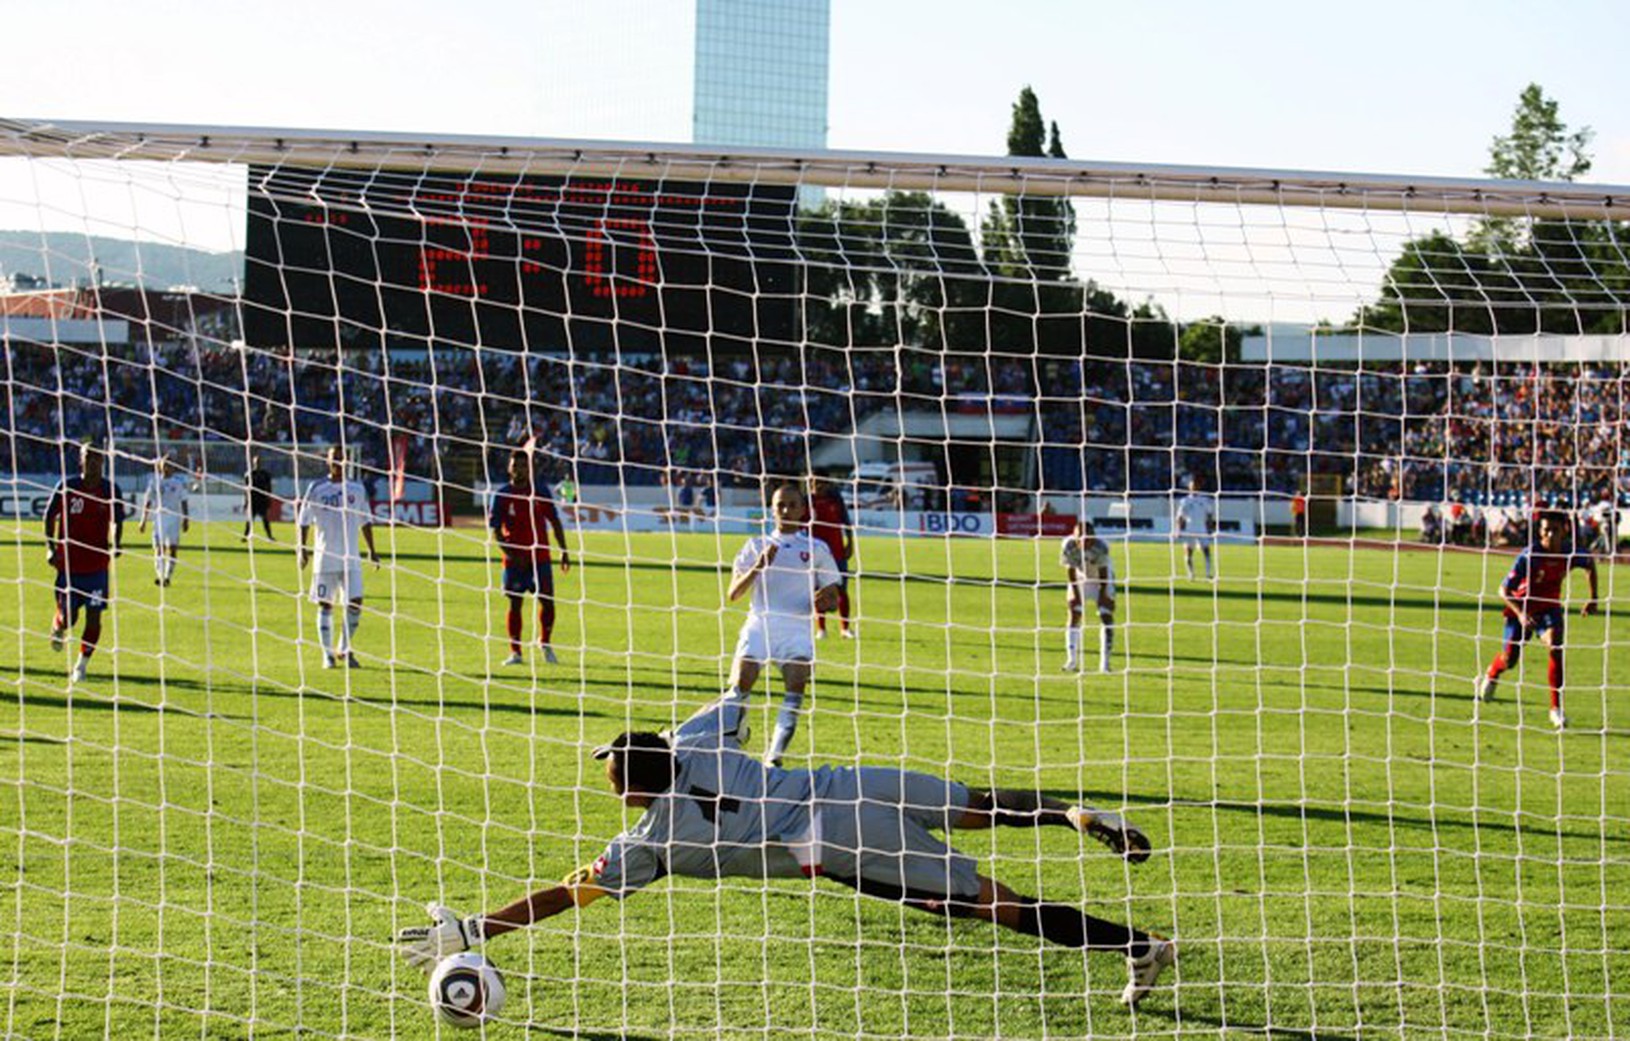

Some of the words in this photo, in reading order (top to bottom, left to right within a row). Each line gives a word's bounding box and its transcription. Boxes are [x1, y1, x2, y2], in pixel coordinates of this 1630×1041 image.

[69, 497, 84, 514] 20
[374, 503, 438, 524] SME
[926, 514, 981, 532] BDO
